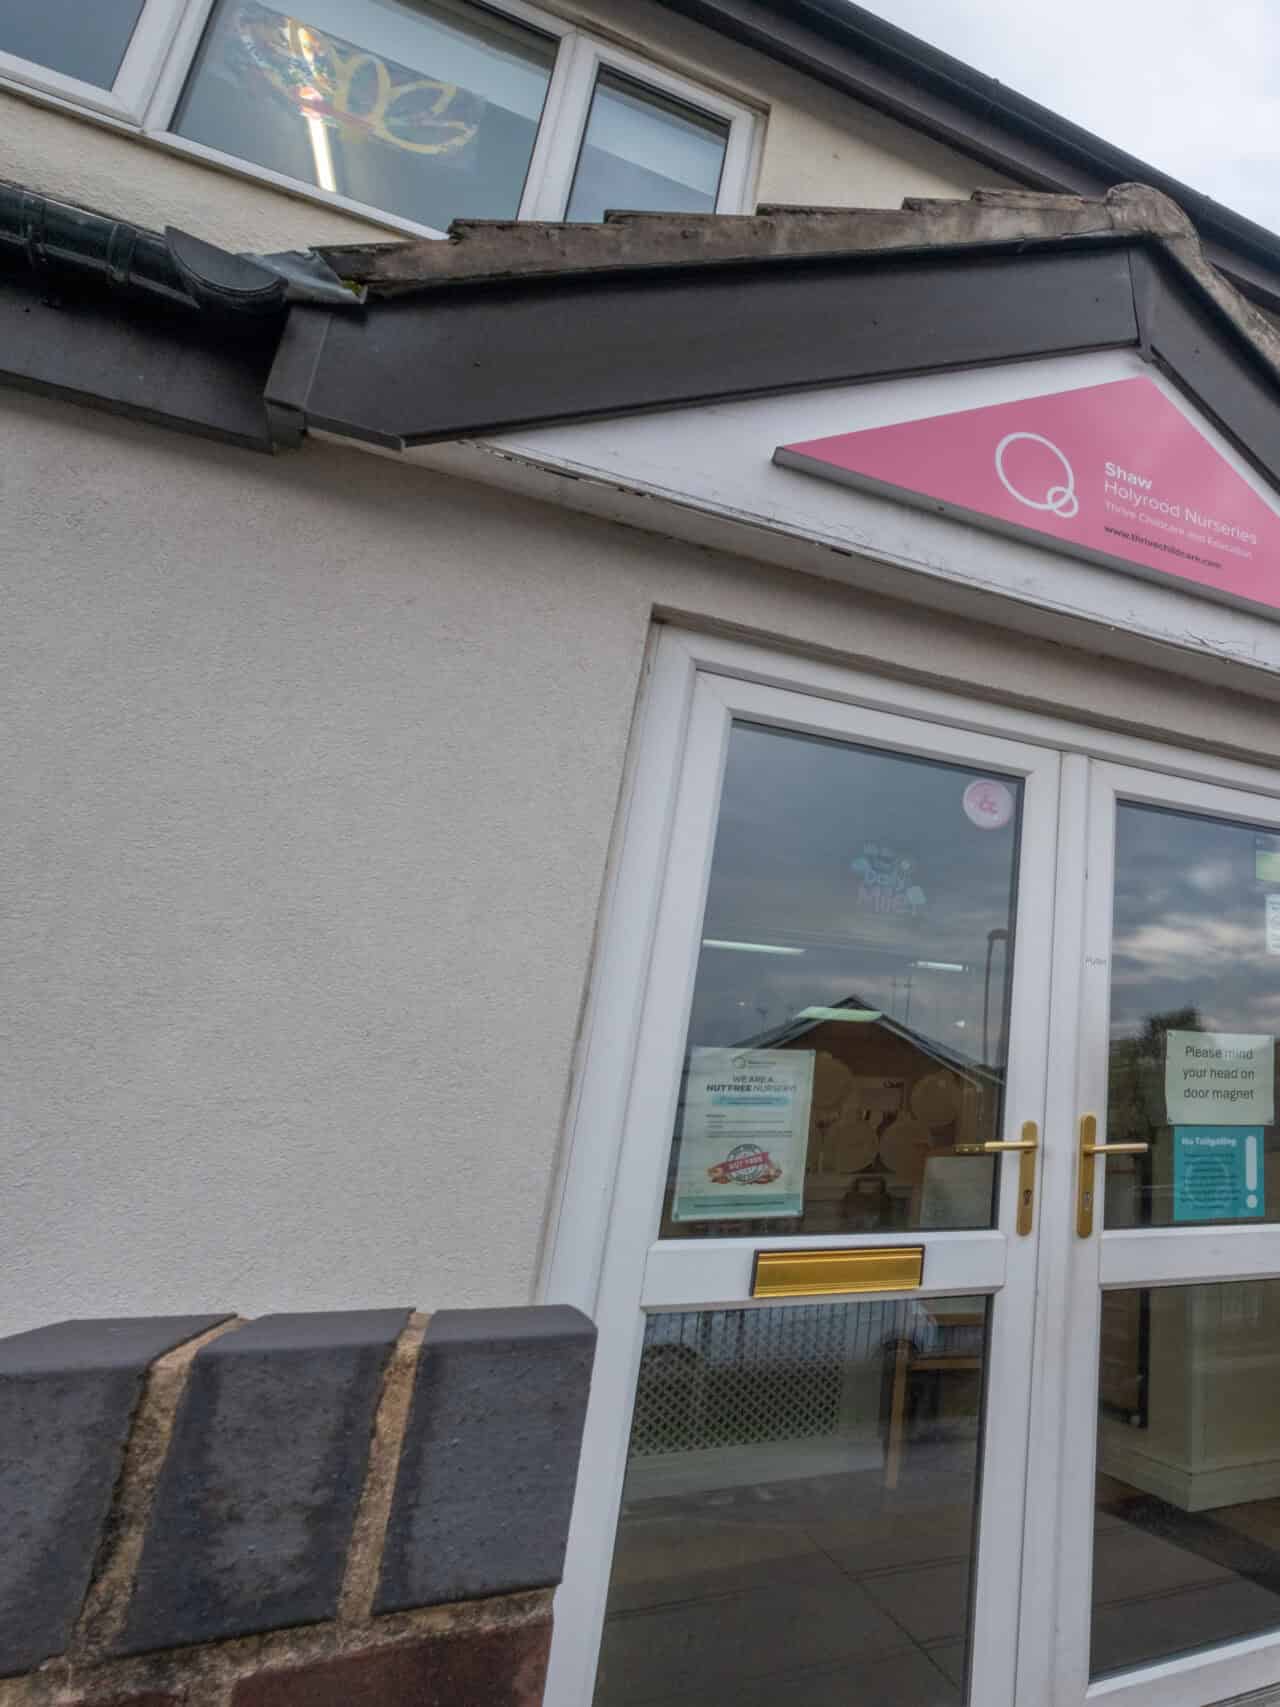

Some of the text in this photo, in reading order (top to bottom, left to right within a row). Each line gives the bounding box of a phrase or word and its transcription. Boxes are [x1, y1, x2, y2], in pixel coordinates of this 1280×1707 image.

[1104, 462, 1152, 489] Shaw
[1104, 480, 1257, 545] Holyrood Nurseries
[1185, 1045, 1222, 1058] Please
[1183, 1068, 1255, 1081] your head on
[1184, 1087, 1255, 1102] door magnet
